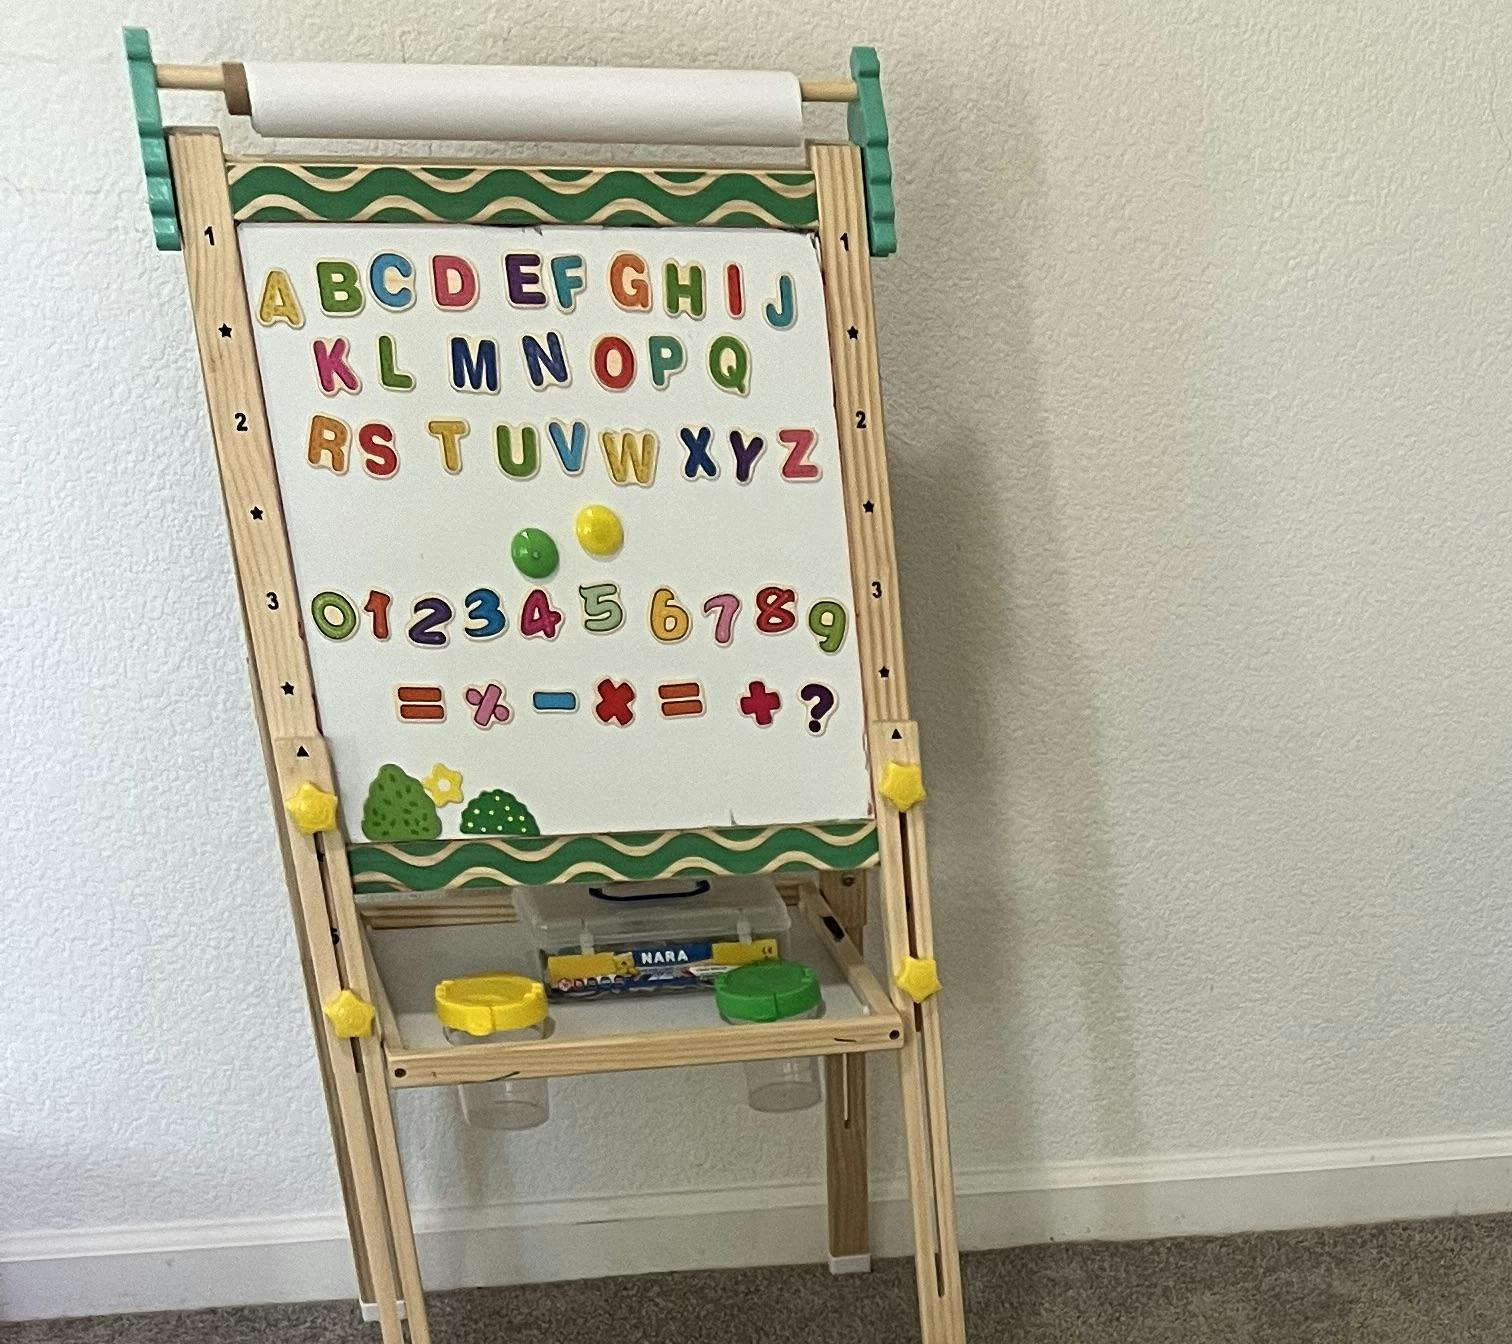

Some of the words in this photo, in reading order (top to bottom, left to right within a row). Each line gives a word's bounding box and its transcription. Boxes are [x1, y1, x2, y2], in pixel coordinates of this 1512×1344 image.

[203, 226, 216, 247] 1
[840, 232, 850, 252] 1
[234, 411, 248, 432] 2
[855, 411, 867, 430] 2
[872, 582, 883, 599] 3
[265, 591, 279, 611] 3
[800, 684, 833, 733] ?
[641, 949, 689, 965] NARA
